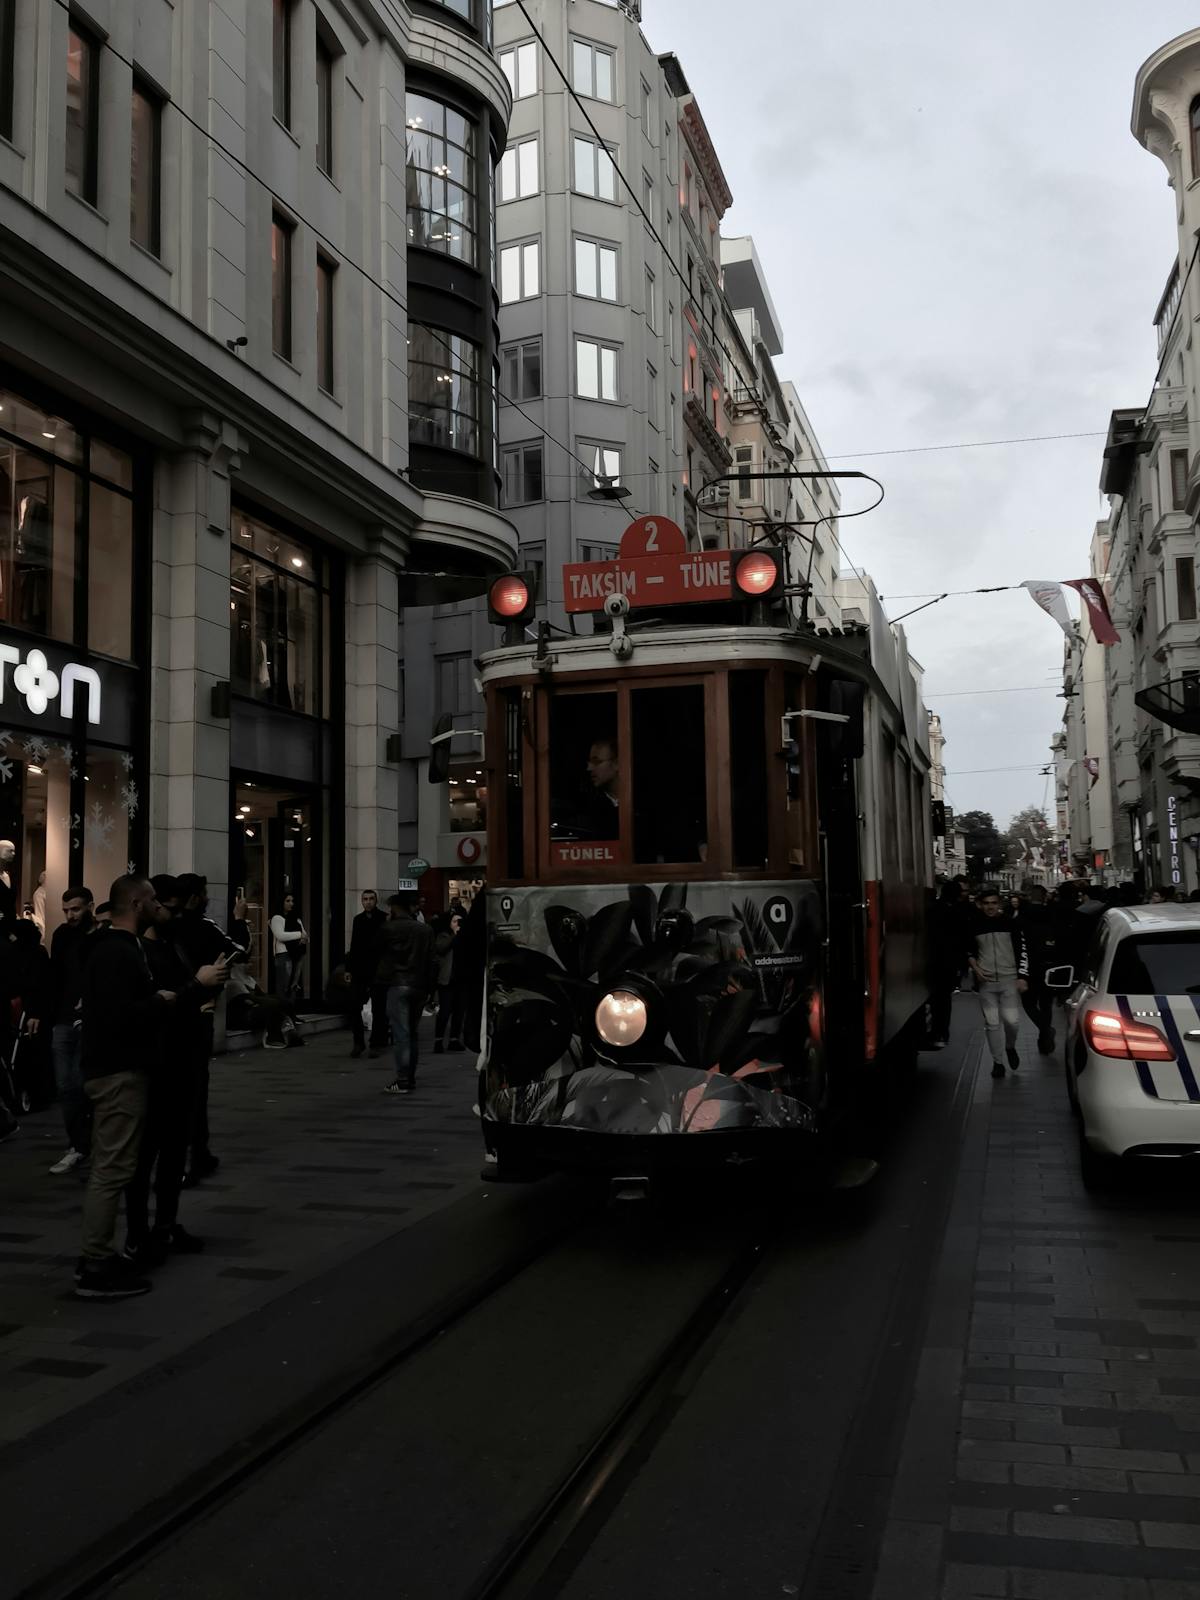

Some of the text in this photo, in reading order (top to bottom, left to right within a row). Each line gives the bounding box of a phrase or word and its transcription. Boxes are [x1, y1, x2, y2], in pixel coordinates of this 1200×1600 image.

[644, 520, 660, 552] 2
[569, 564, 637, 599] TAKSİM
[679, 555, 731, 589] TÜNE
[559, 845, 614, 861] TÜNEL
